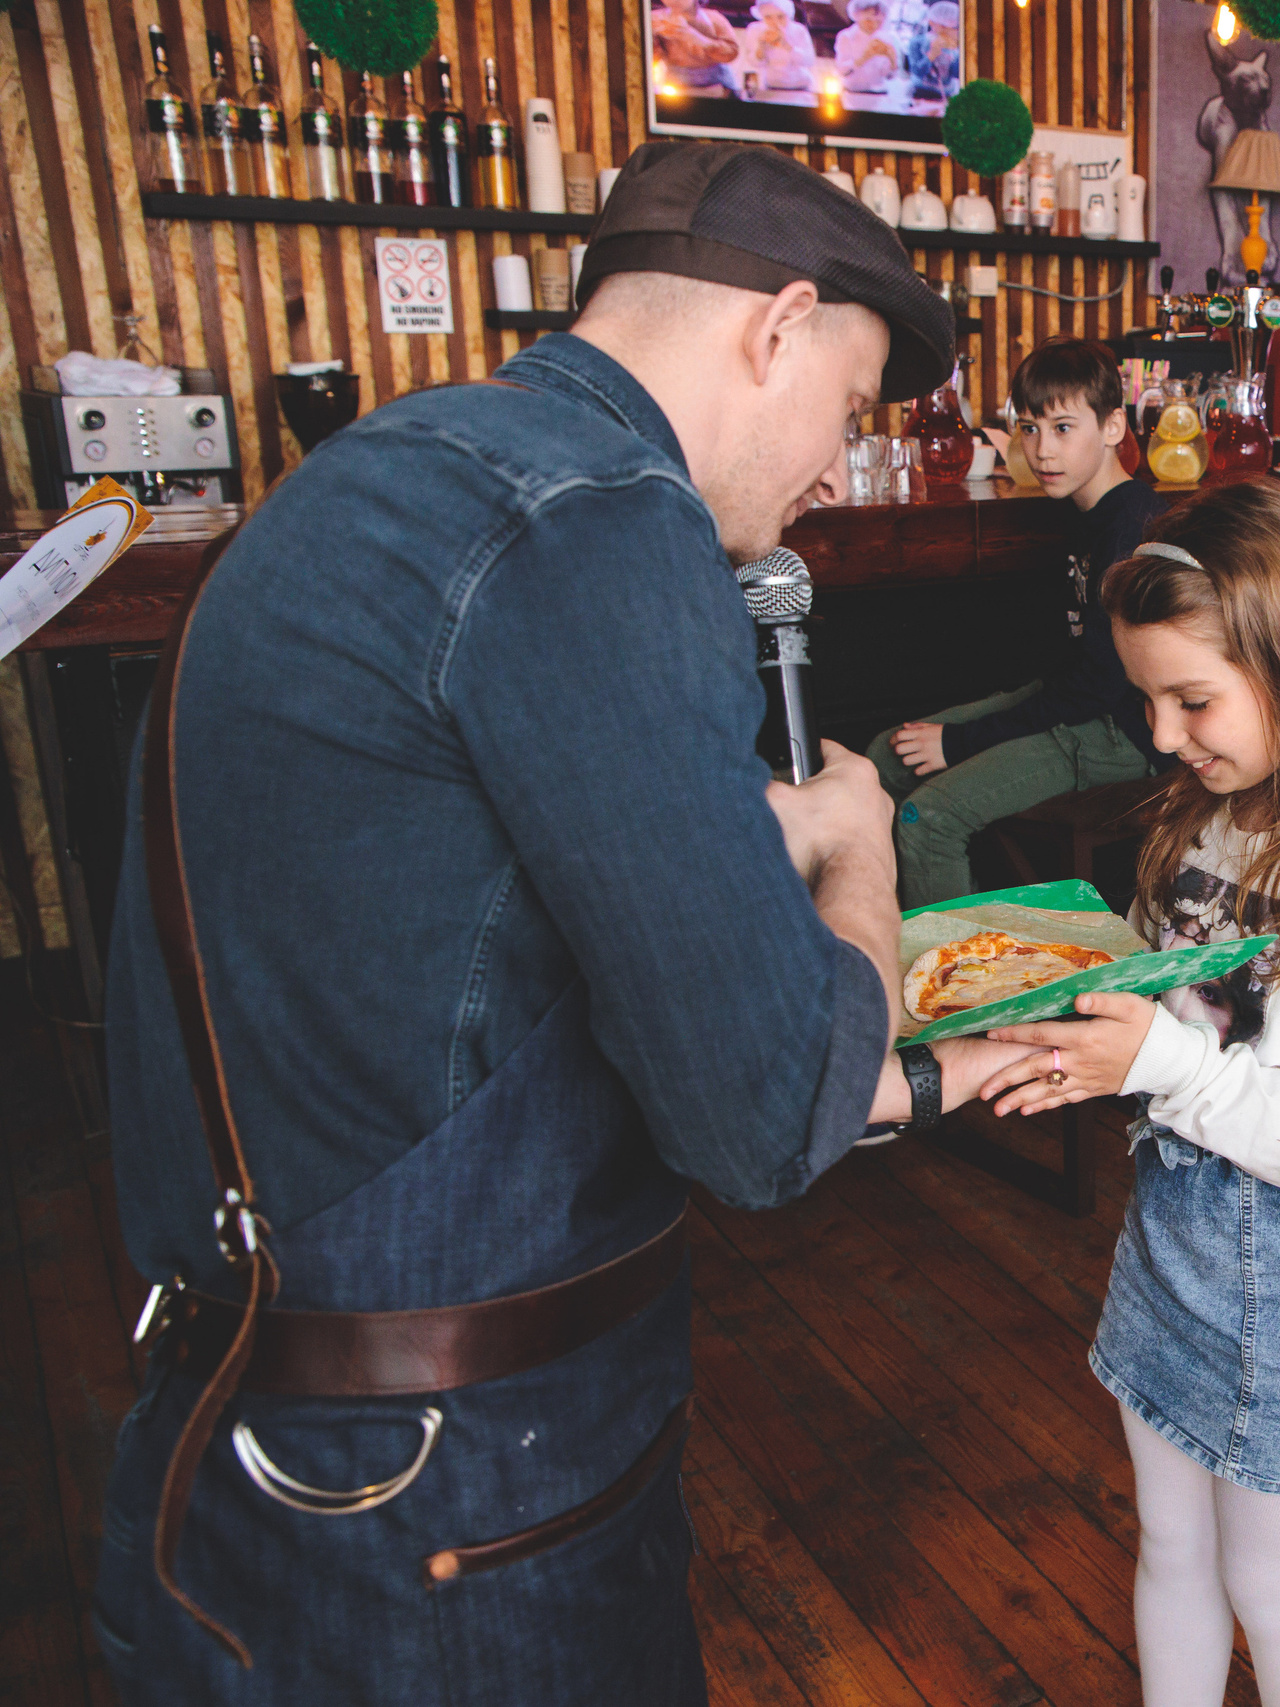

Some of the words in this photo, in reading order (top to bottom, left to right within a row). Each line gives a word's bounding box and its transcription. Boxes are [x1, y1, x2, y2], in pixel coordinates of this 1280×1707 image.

[391, 305, 402, 314] NO
[405, 305, 443, 315] SMOKING
[396, 317, 407, 326] NO
[411, 317, 440, 327] VAPING
[28, 548, 83, 601] ДИПЛОМ
